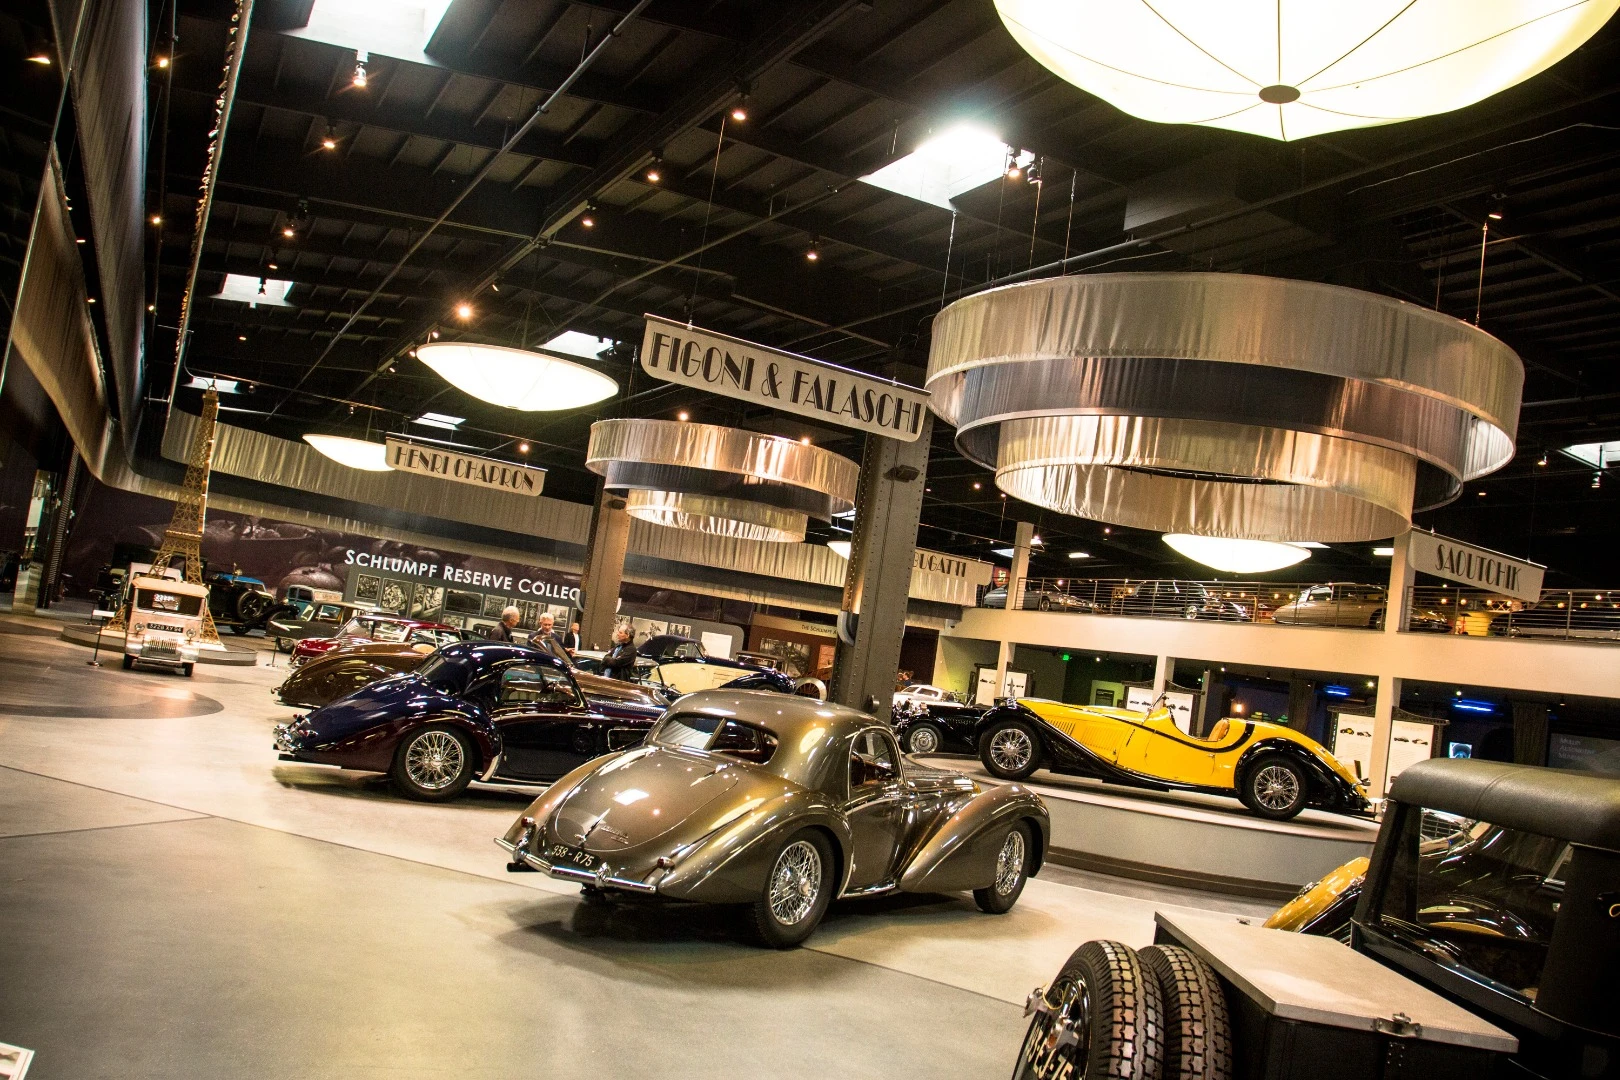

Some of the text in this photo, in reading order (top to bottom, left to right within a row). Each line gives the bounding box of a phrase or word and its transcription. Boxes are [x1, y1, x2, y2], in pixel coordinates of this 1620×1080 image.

[648, 331, 922, 435] FIGONI & FALASCHI
[394, 446, 536, 491] HENRI CHAPRON
[344, 549, 438, 578] SCHLUMPF
[443, 565, 513, 591] RESERVE
[1435, 543, 1522, 592] SAOUTCHIK
[551, 845, 569, 858] 938
